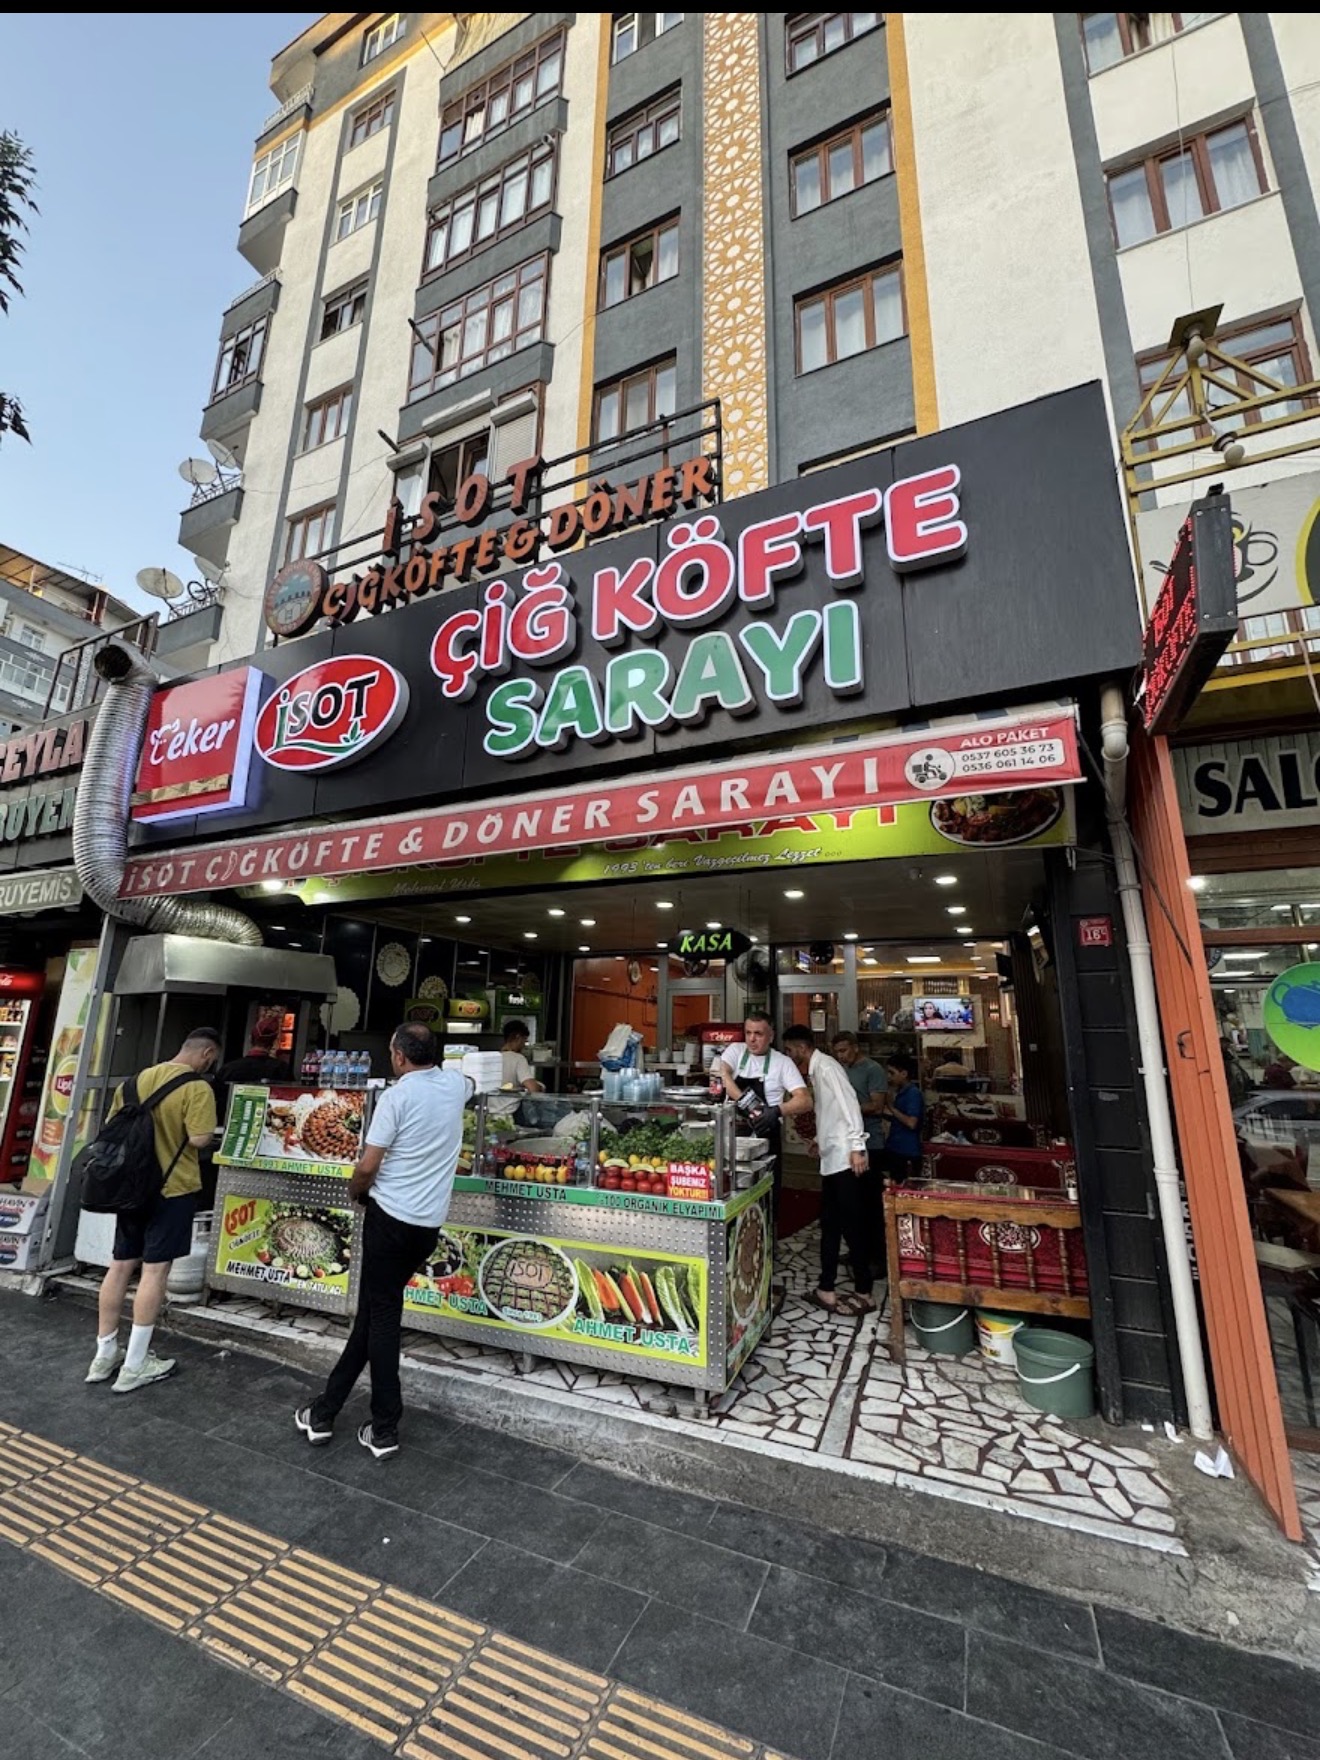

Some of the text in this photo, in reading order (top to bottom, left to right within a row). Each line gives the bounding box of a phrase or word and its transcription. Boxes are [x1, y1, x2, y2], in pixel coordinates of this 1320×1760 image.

[504, 519, 540, 559] &
[549, 456, 714, 548] DÖNER
[431, 562, 574, 698] ÇİĞ
[592, 464, 968, 649] KÖFTE
[483, 600, 861, 757] SARAYI
[960, 727, 1049, 748] ALO PAKET
[0, 718, 86, 784] EYLA
[961, 743, 1054, 762] 0537 605 36 73
[962, 754, 1056, 772] 0536 061 14 06
[398, 827, 424, 856] &
[442, 800, 612, 850] DÖNER
[636, 756, 879, 824] SARAYI
[680, 932, 732, 953] KASA
[281, 1162, 314, 1174] AHMET
[317, 1166, 343, 1177] USTA
[671, 1163, 706, 1176] BAŞKA
[485, 1180, 566, 1200] MEHMET USTA
[226, 1260, 292, 1284] MEHMET USTA
[404, 1286, 488, 1316] HMET USTA
[573, 1317, 691, 1355] AHMET USTA
